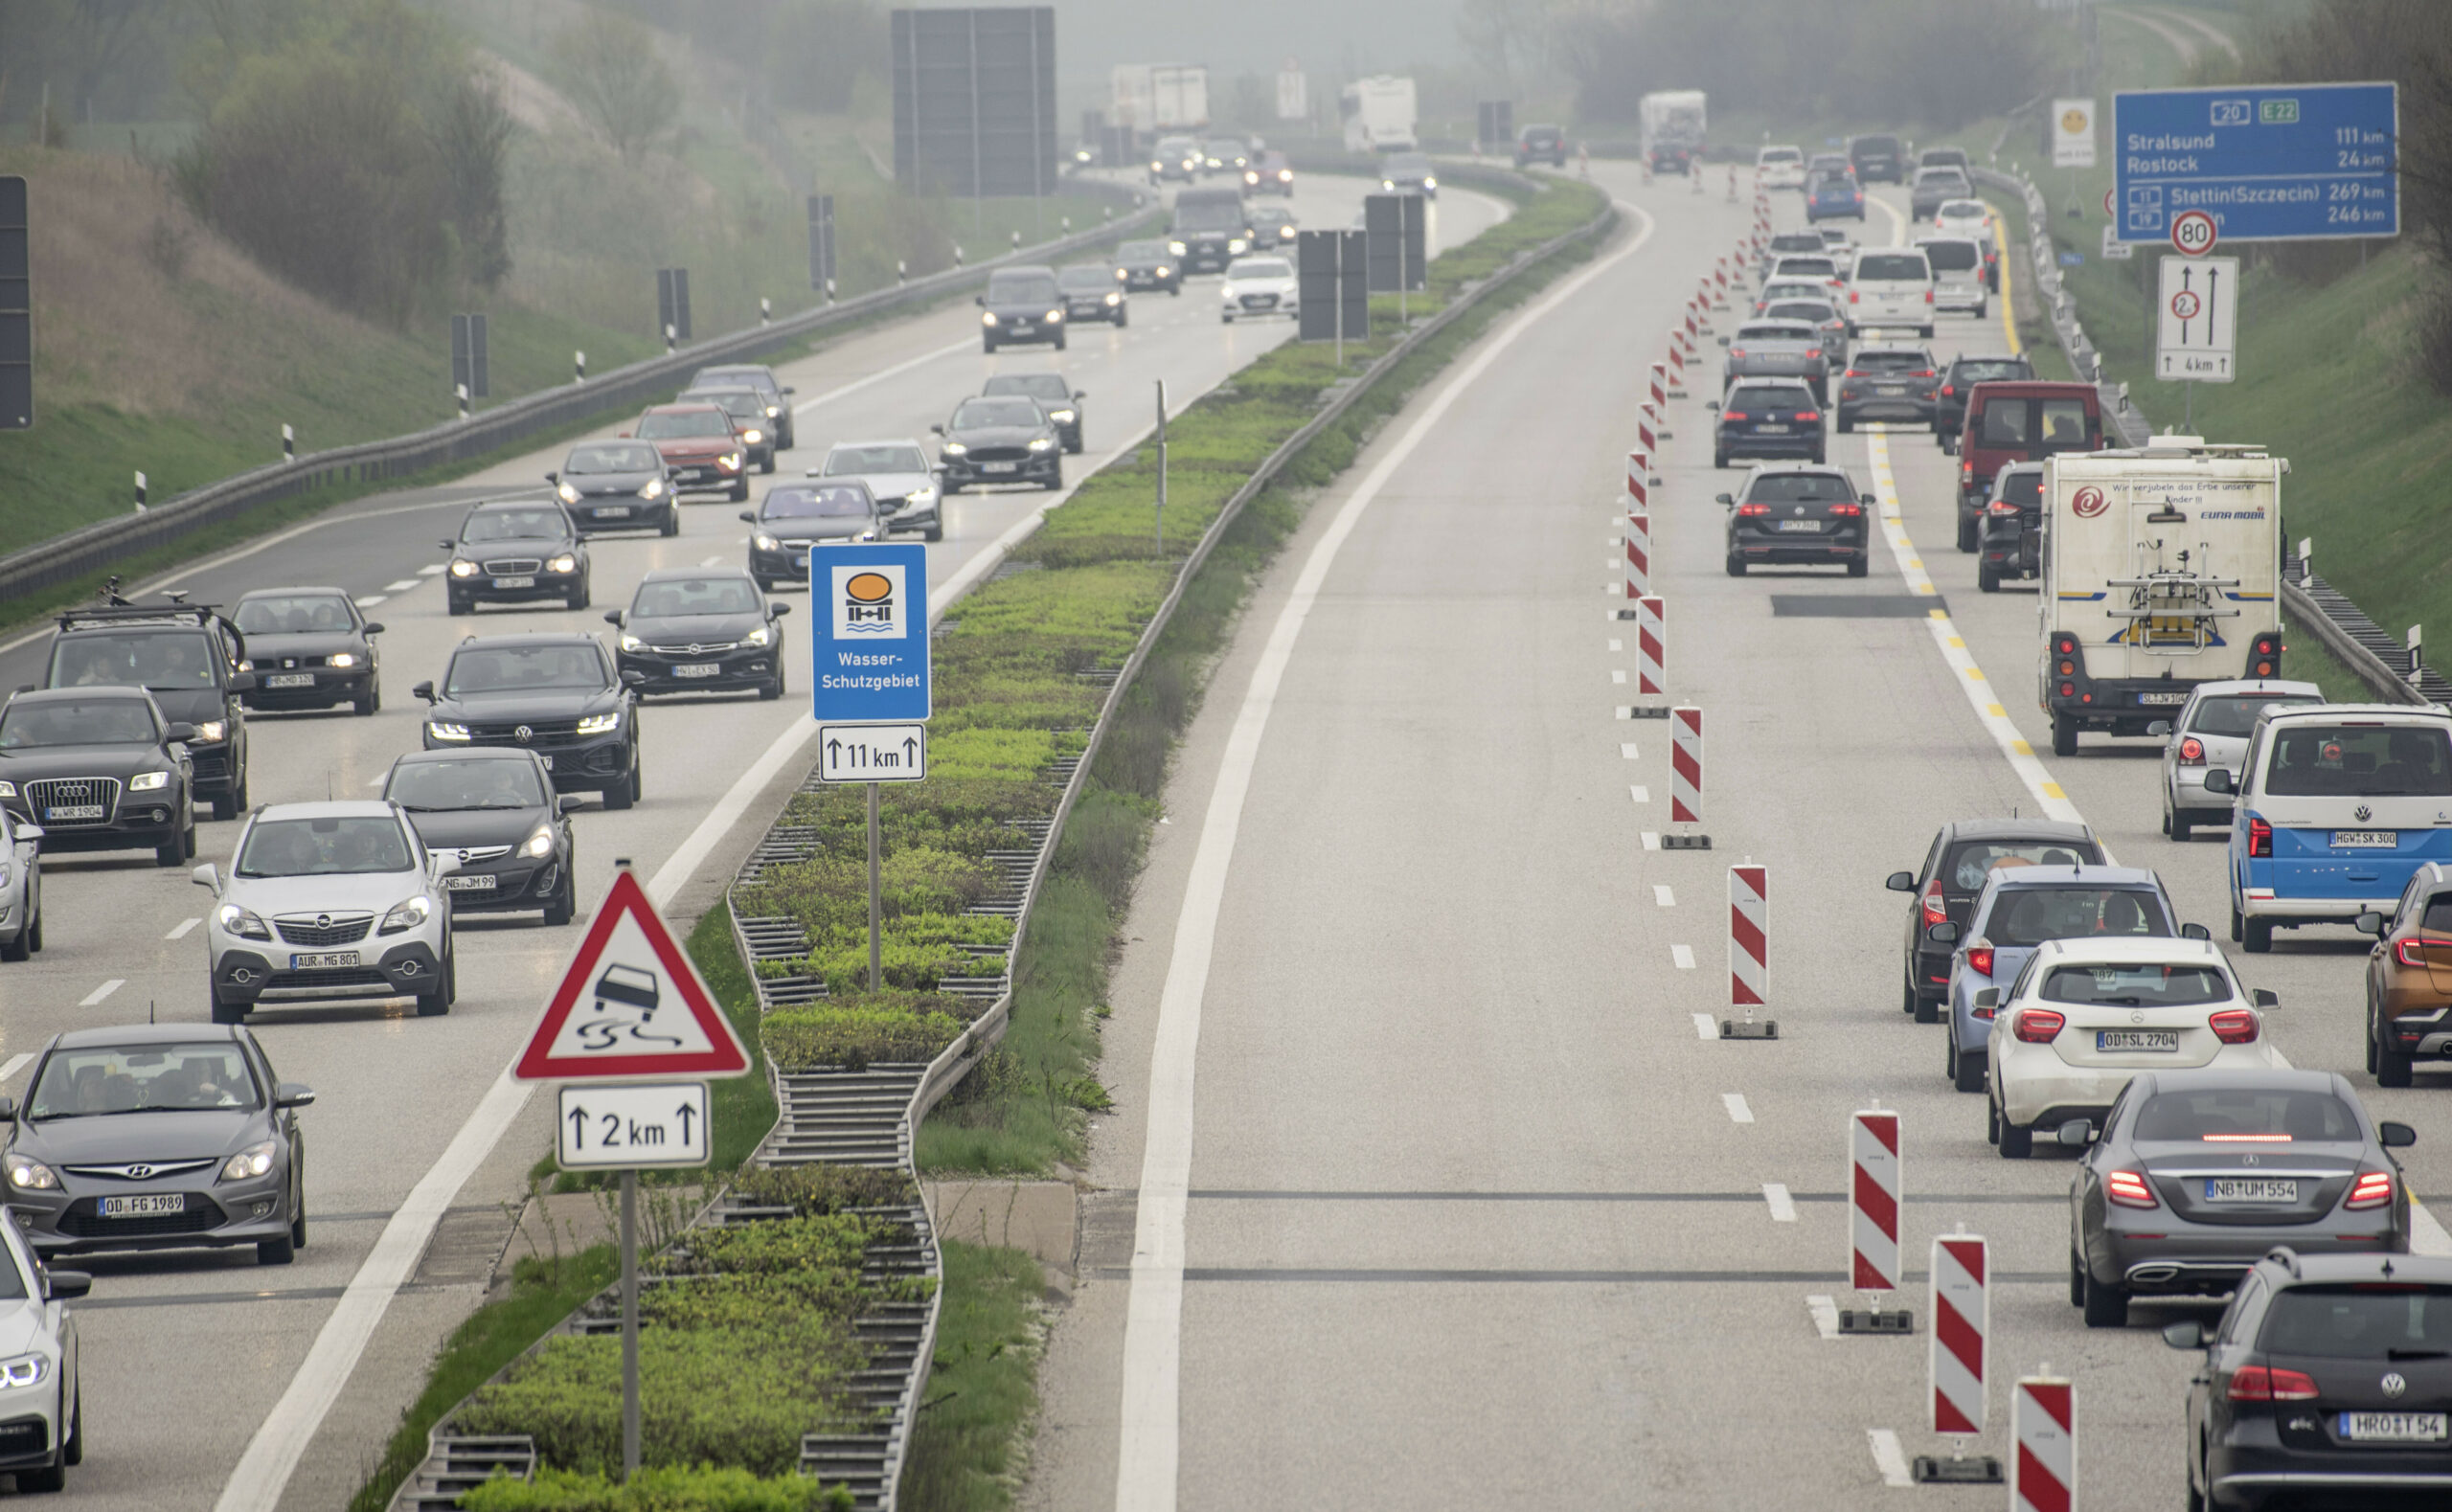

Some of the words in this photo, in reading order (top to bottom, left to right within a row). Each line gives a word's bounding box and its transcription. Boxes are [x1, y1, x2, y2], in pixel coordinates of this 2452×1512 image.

[2221, 105, 2241, 121] 20
[2127, 133, 2215, 151] Stralsund
[2337, 127, 2358, 145] 111
[2363, 130, 2385, 144] km
[2127, 155, 2198, 172] Rostock
[2338, 150, 2360, 168] 24
[2363, 153, 2385, 167] km
[2328, 183, 2361, 201] 269
[2363, 186, 2385, 199] km
[2327, 205, 2361, 223] 246
[2363, 208, 2385, 221] km
[2182, 223, 2208, 243] 80
[2185, 357, 2192, 372] 4
[2195, 357, 2214, 372] km
[2197, 483, 2218, 491] Erbe
[838, 652, 903, 666] Wasser-
[822, 673, 920, 691] Schutzgebiet
[848, 744, 867, 768] 11
[874, 747, 899, 767] km
[2337, 833, 2356, 844] HGW
[2362, 833, 2375, 844] SK
[2377, 833, 2395, 844] 300
[482, 876, 495, 887] 99
[298, 956, 318, 967] AUR
[324, 955, 338, 966] MG
[339, 954, 358, 965] 801
[2105, 1033, 2122, 1047] OD
[2129, 1033, 2145, 1047] SL
[2146, 1033, 2176, 1047] 2704
[602, 1114, 621, 1146] 2
[629, 1117, 665, 1145] km
[2214, 1182, 2235, 1196] NB
[2244, 1182, 2264, 1196] UM
[2267, 1182, 2295, 1196] 554
[106, 1199, 123, 1212] OD
[131, 1197, 148, 1211] FG
[151, 1195, 182, 1210] 1989
[2356, 1416, 2391, 1433] HRO
[2418, 1415, 2439, 1433] 54
